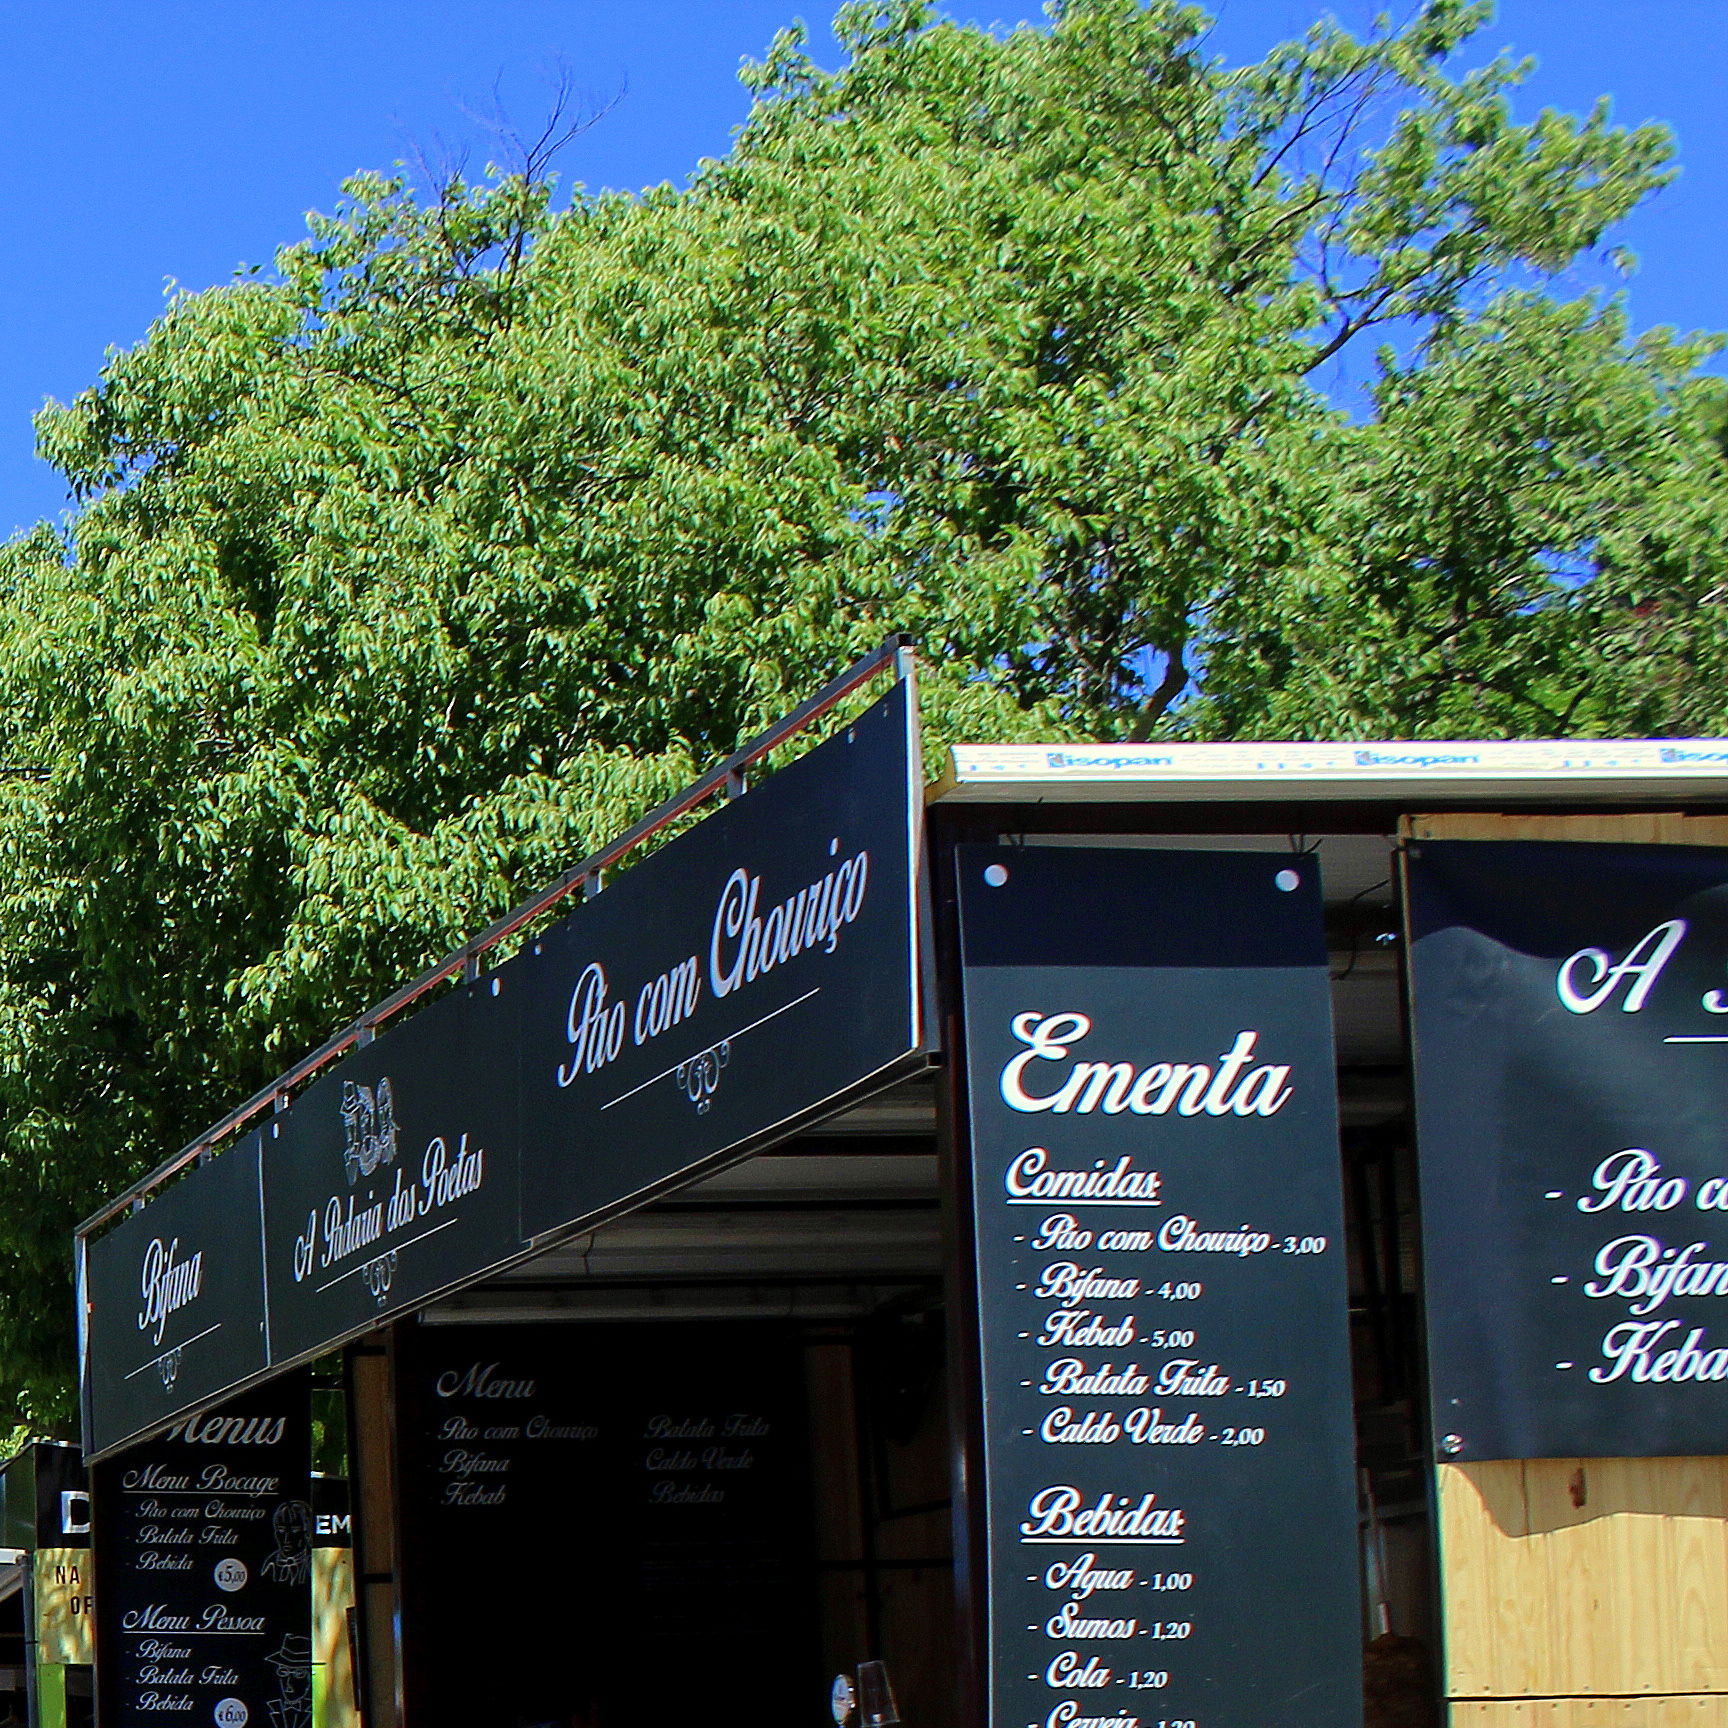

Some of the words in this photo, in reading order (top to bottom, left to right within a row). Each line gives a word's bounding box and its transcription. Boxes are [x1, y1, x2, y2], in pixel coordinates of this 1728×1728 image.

[1063, 753, 1175, 770] isopan
[1370, 752, 1481, 769] isopan
[634, 955, 701, 1046] com
[710, 837, 869, 999] Chouriço
[1555, 918, 1689, 1015] A
[1001, 1011, 1294, 1117] Ementa
[1005, 1147, 1162, 1199] Comidas:
[295, 1209, 317, 1283] A
[321, 1190, 383, 1269] Padaria
[418, 1132, 484, 1216] Poetas
[1097, 1229, 1155, 1252] com
[1157, 1214, 1272, 1258] Chouriço
[1282, 1236, 1328, 1255] 3,00
[139, 1237, 202, 1346] Bifana
[1034, 1261, 1141, 1308] Bifana
[1157, 1282, 1202, 1301] 4,00
[1036, 1310, 1136, 1347] Kebab
[1150, 1330, 1195, 1349] 5,00
[1587, 1319, 1728, 1384] Keba
[437, 1361, 536, 1399] Menu
[1039, 1357, 1150, 1397] Batata
[1153, 1358, 1231, 1397] Frita
[1247, 1379, 1287, 1398] 1,50
[484, 1424, 520, 1441] com
[527, 1415, 599, 1441] Chouriço
[1040, 1406, 1122, 1445] Caldo
[1123, 1407, 1206, 1445] Verde
[1221, 1428, 1266, 1447] 2,00
[122, 1464, 191, 1490] Menu
[196, 1464, 280, 1498] Bocage
[440, 1449, 510, 1480] Bifana
[171, 1506, 199, 1518] com
[204, 1500, 266, 1521] Chouriço
[440, 1482, 507, 1506] Kebab
[1019, 1485, 1187, 1538] Bebidas:
[136, 1525, 193, 1545] Batata
[198, 1525, 239, 1545] Frita
[56, 1566, 80, 1584] NA
[136, 1551, 194, 1570] Bebida
[1152, 1573, 1193, 1591] 1,00
[122, 1604, 191, 1630] Menu
[196, 1604, 266, 1630] Pessoa
[1045, 1602, 1137, 1640] Sumos
[1152, 1622, 1191, 1641] 1,20
[136, 1639, 192, 1662] Bifana
[136, 1665, 194, 1685] Batata
[198, 1665, 240, 1685] Frita
[1045, 1651, 1111, 1689] Cola
[1128, 1671, 1168, 1691] 1,20
[136, 1691, 194, 1711] Bebida
